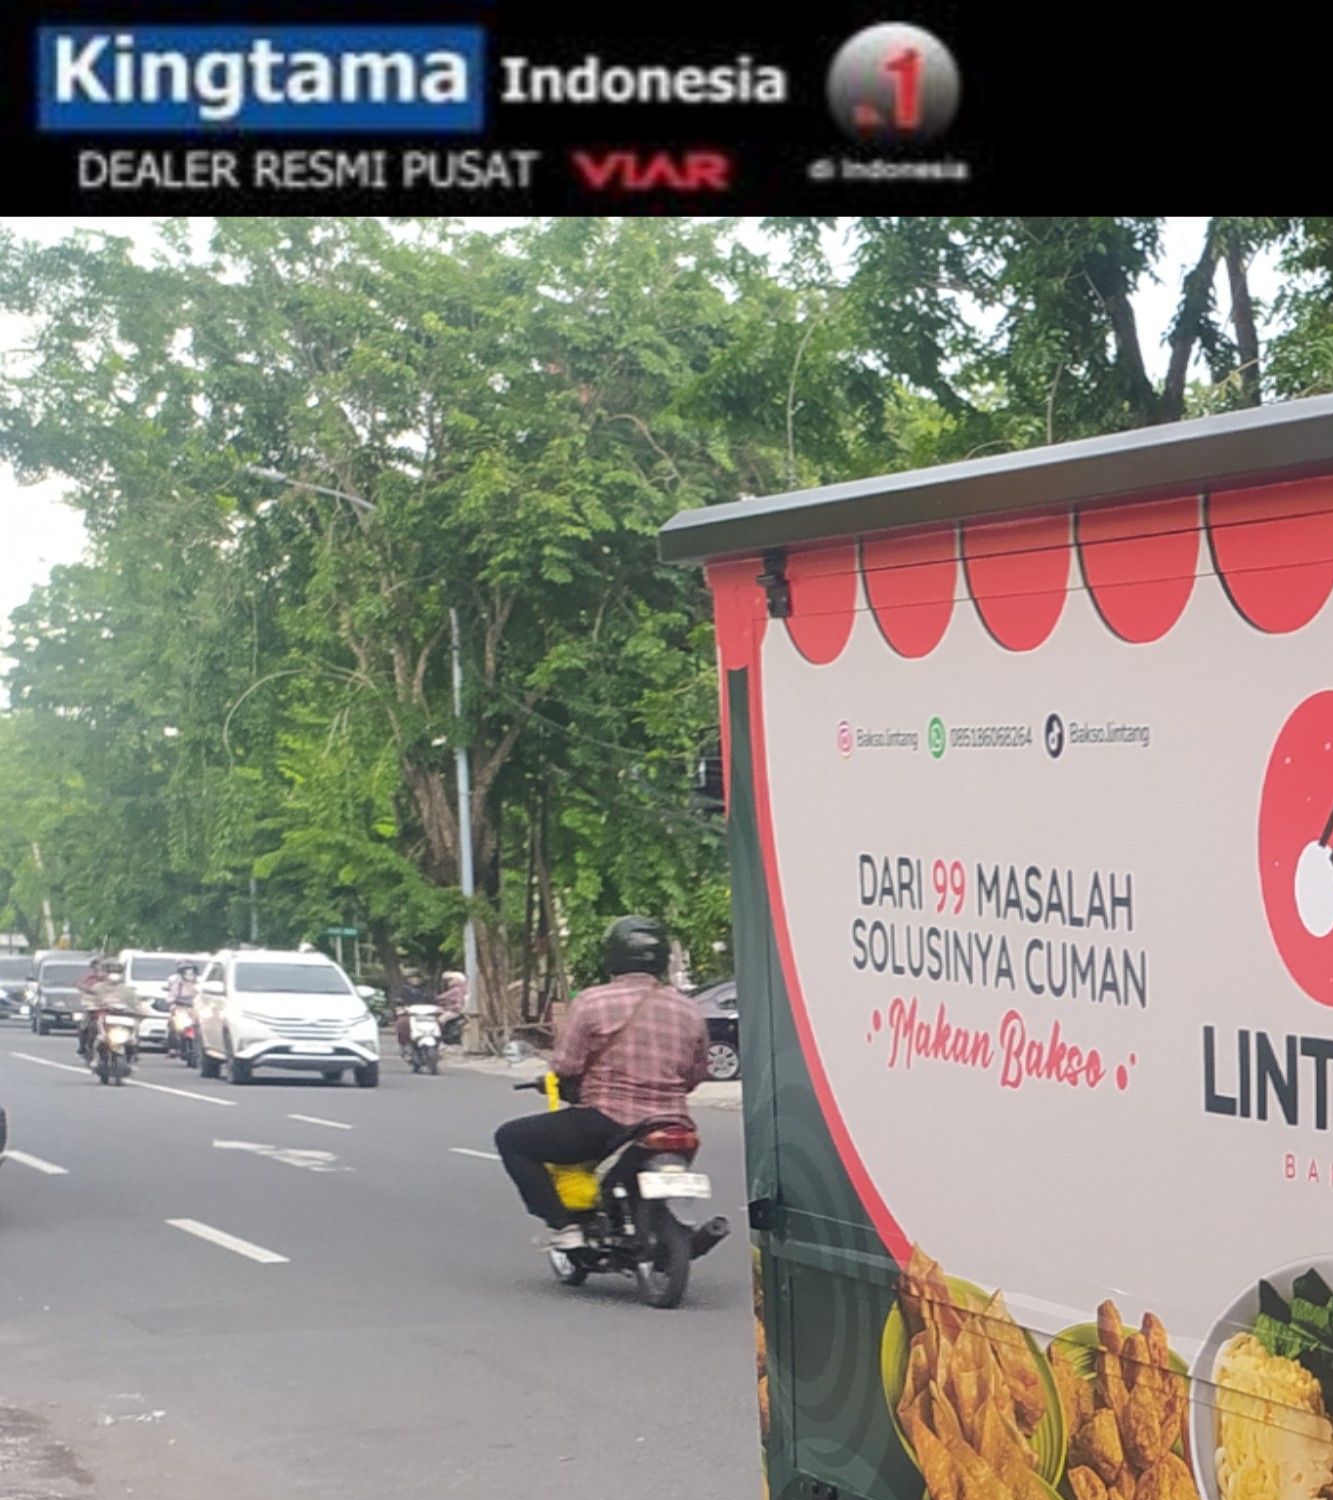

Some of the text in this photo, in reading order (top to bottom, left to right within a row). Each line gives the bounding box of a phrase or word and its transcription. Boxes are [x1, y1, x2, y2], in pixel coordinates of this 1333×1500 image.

[859, 853, 1133, 932] DARI 99 MASALAH
[852, 918, 1147, 1009] SOLUSINYA CUMAN
[888, 996, 1106, 1089] Makan Bakso
